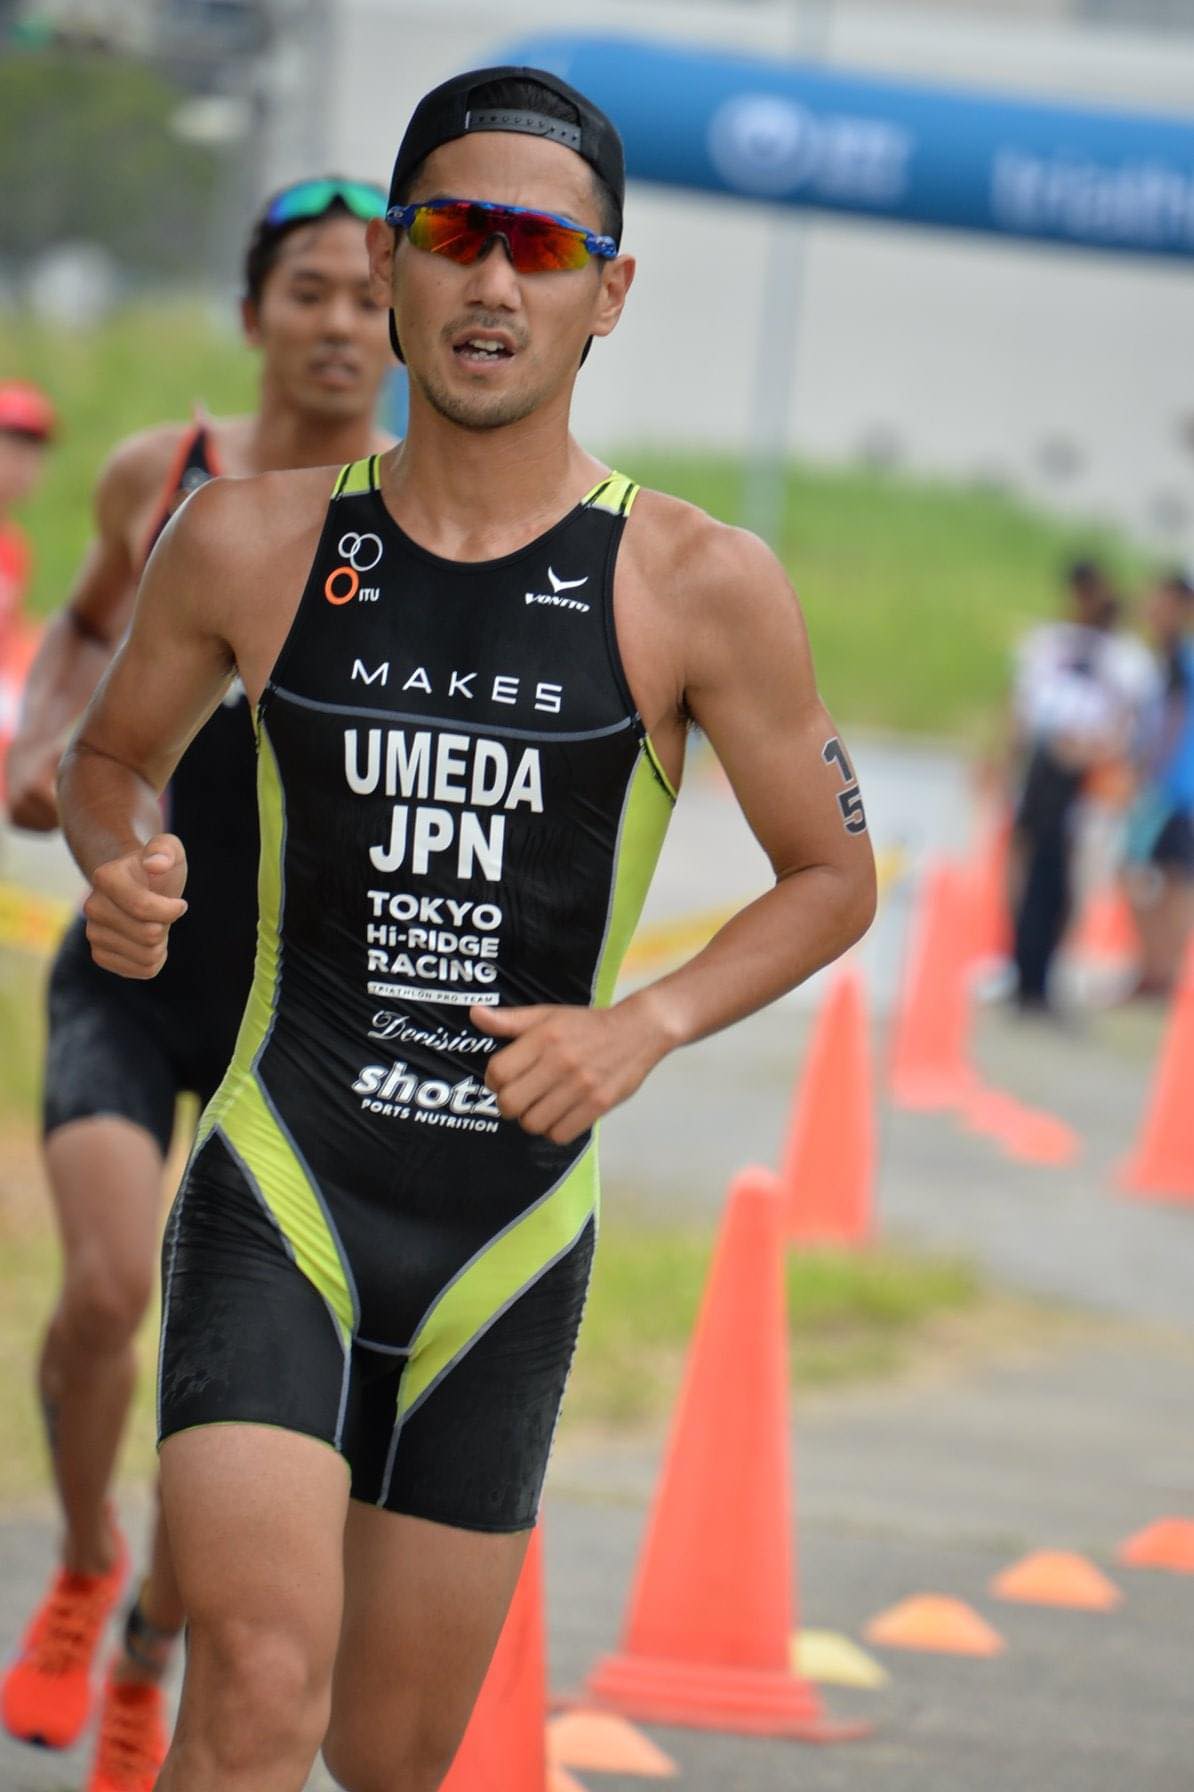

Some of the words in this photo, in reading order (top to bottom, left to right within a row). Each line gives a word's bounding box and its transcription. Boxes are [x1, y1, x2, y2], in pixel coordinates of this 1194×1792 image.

[358, 587, 381, 602] ITU
[350, 658, 563, 713] MAKES
[344, 728, 544, 813] UMEDA
[369, 804, 506, 882] JPN
[367, 889, 503, 931] TOKYO
[366, 922, 500, 959] Hi-RIDGE
[367, 948, 498, 984] RACING
[372, 984, 433, 999] TRIATHLON
[436, 993, 459, 1002] PRO
[464, 995, 494, 1004] TEAM
[367, 1009, 497, 1054] Decision
[414, 1110, 499, 1133] NUTRITION
